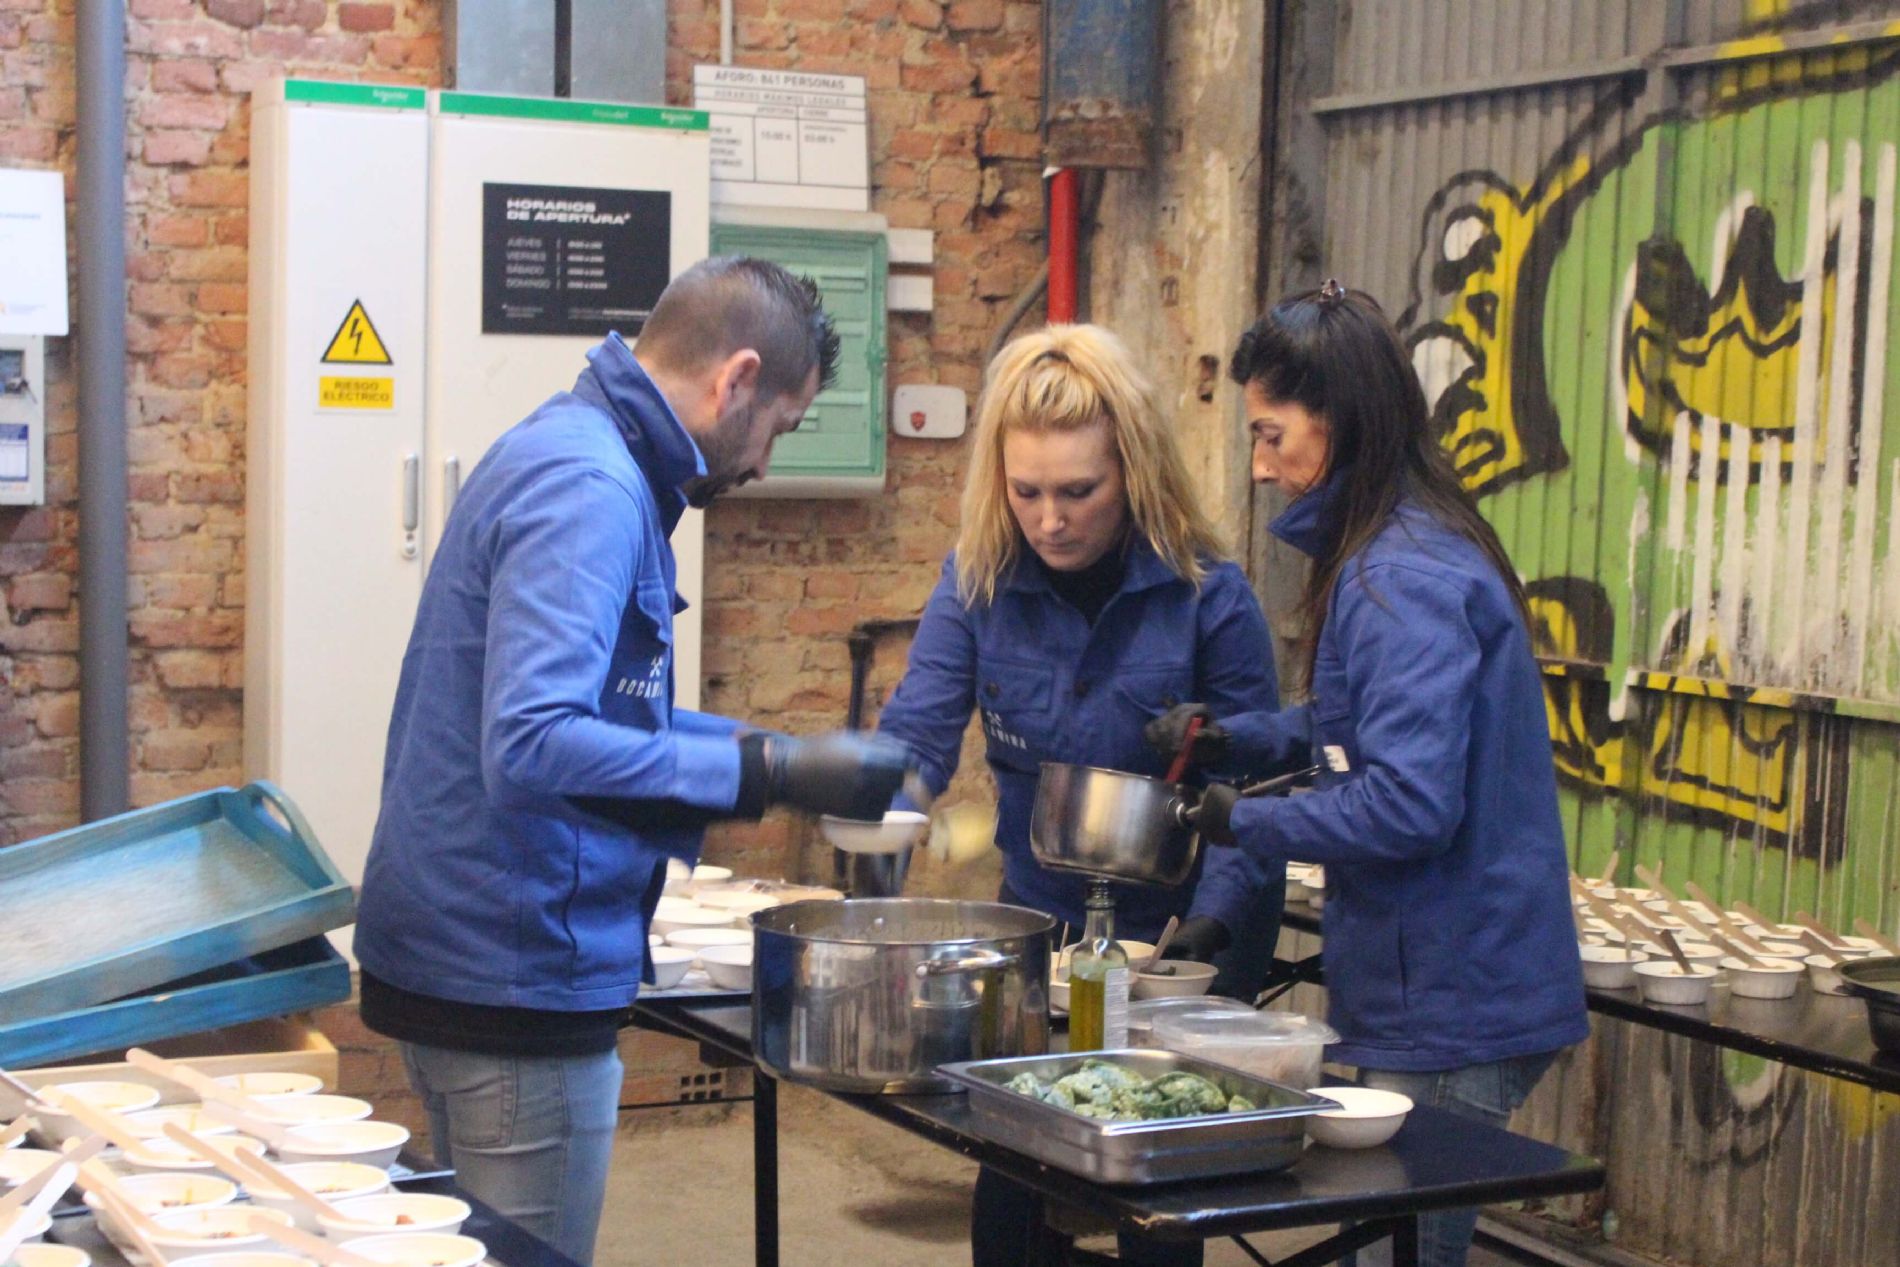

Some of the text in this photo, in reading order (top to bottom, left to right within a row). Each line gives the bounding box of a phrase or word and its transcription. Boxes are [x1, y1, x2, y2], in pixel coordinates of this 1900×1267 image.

[783, 76, 845, 91] PERSONAS
[506, 198, 597, 213] HORARIOS
[506, 210, 530, 222] DE
[334, 381, 379, 391] RIESGO
